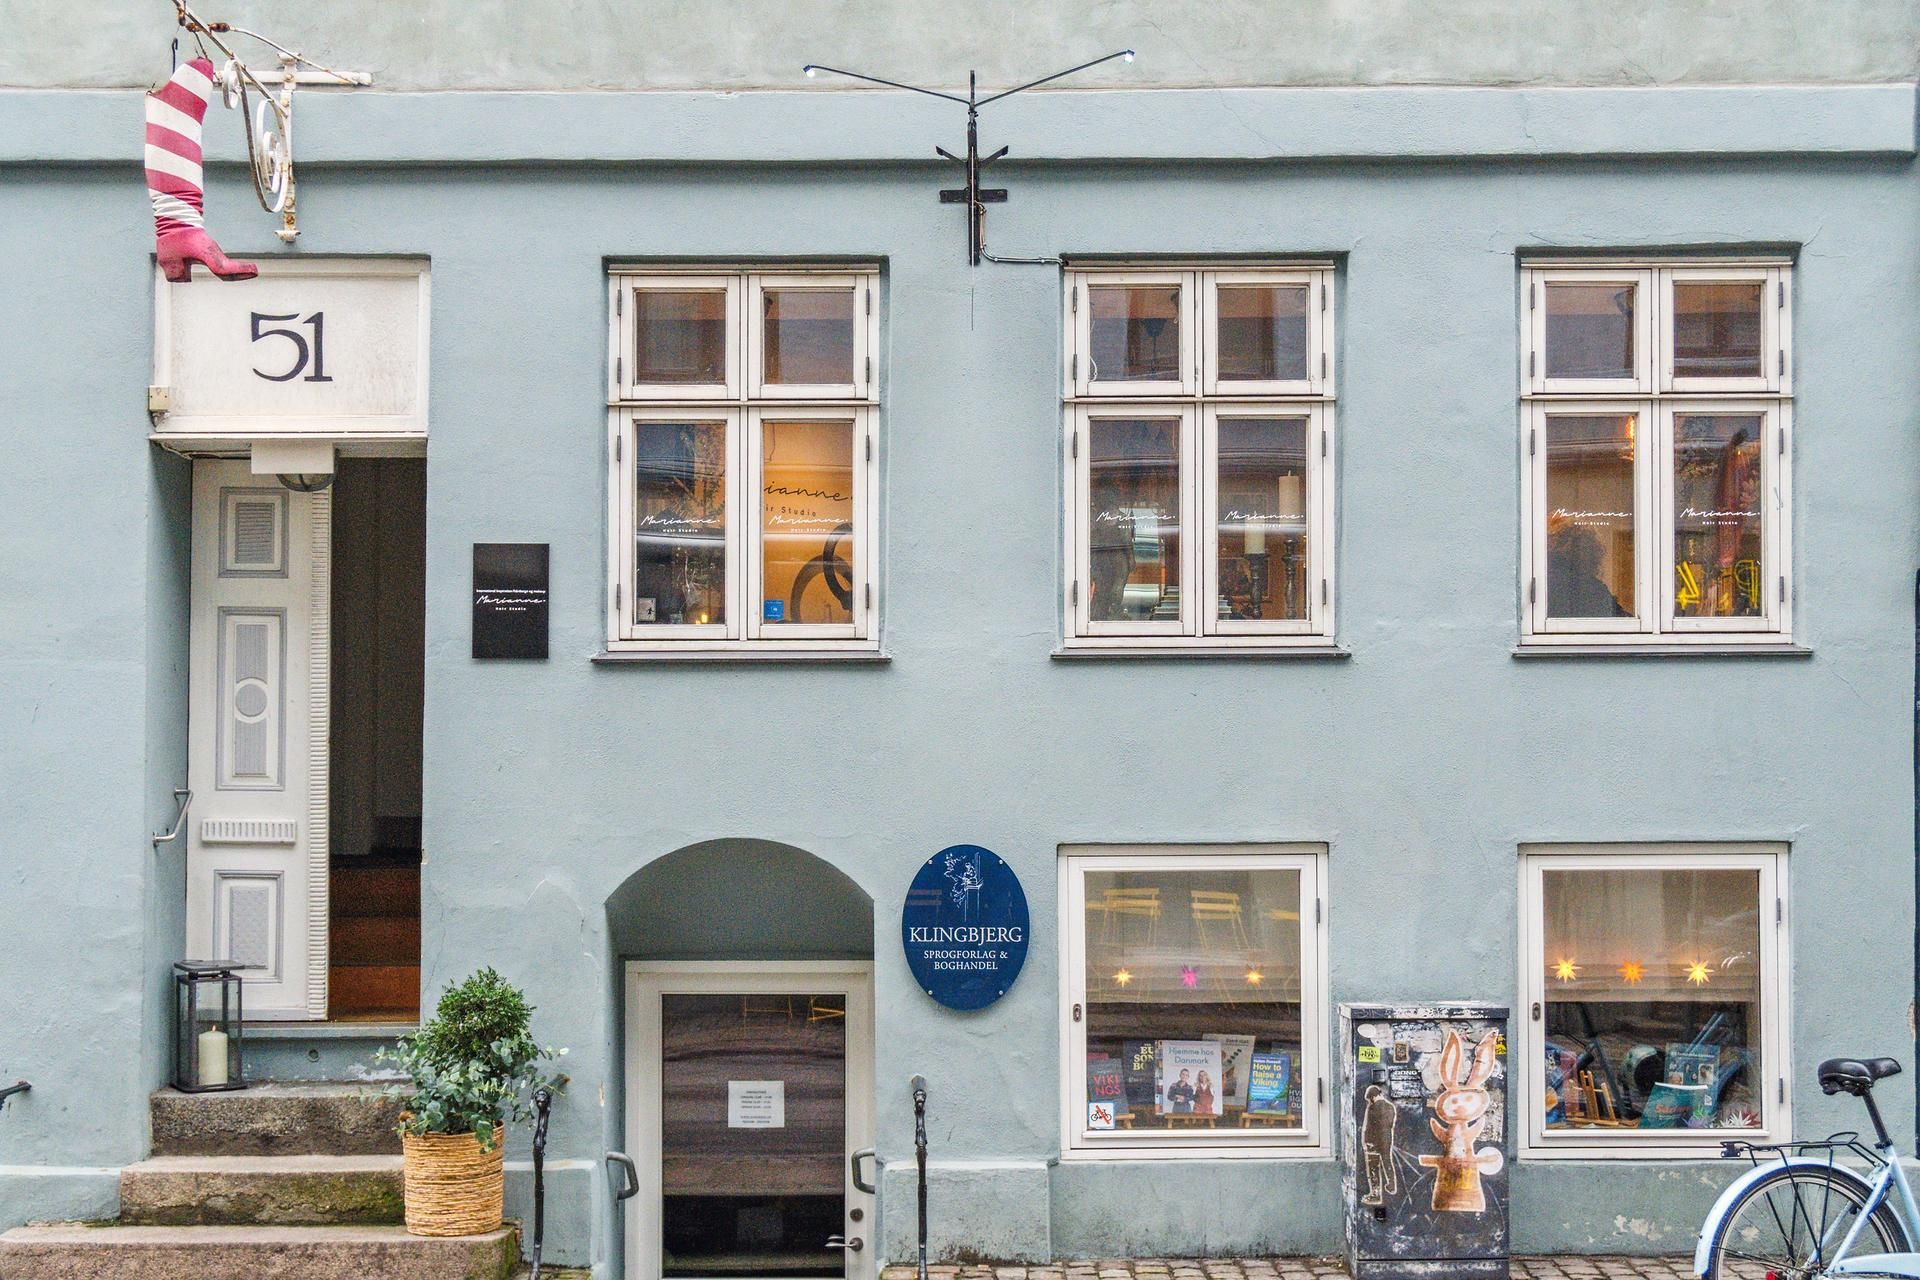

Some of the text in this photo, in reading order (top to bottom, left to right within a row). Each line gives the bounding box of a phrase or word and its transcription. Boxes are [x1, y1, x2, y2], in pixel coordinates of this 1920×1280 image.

[251, 312, 333, 383] 51
[781, 506, 817, 517] Studio
[909, 927, 1023, 945] KLINGBJERG
[923, 950, 1008, 959] SPROGFORLAG &
[934, 961, 998, 970] BOGHANDEL
[1168, 1046, 1214, 1056] Hjemme hos
[1174, 1056, 1209, 1065] Danmark
[1253, 1063, 1271, 1071] How
[1252, 1078, 1279, 1088] Viking
